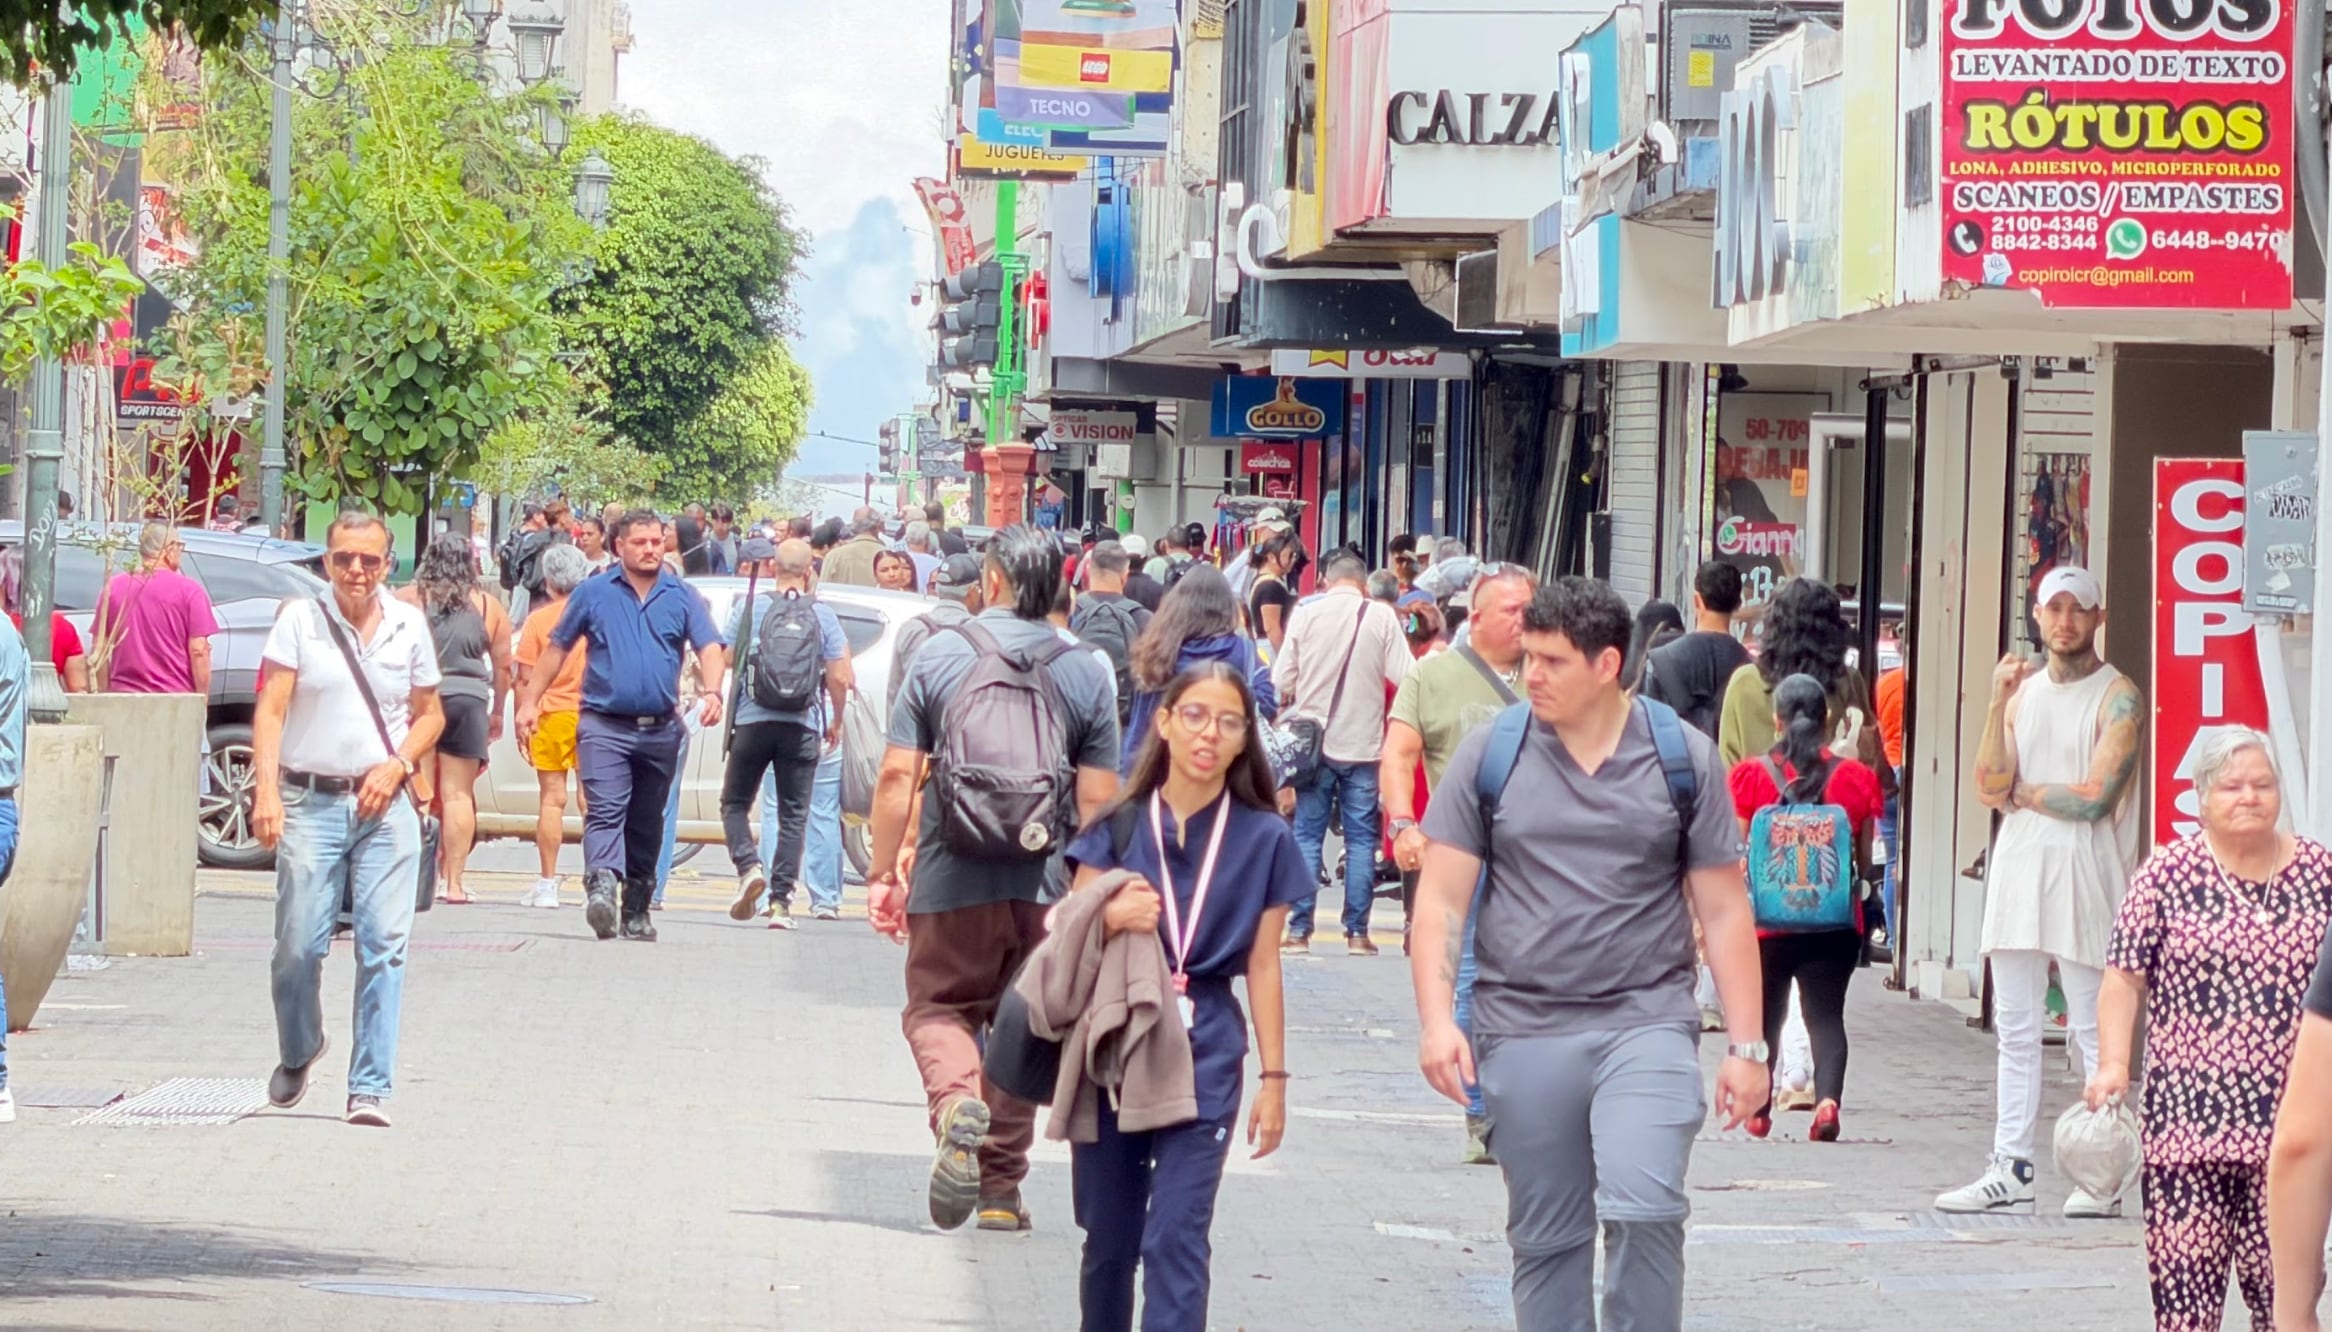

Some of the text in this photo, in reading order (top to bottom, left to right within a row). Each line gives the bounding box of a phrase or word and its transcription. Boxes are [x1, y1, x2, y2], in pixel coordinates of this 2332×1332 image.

[1956, 54, 2281, 79] LEVANTADO DE TEXTO
[1030, 99, 1091, 117] TECNO
[1966, 92, 2264, 150] RÓTULOS
[1950, 161, 2281, 178] LONA, ADHESIVO, MICROPERFORADO
[1992, 216, 2099, 233] 2100-4346
[1992, 234, 2098, 251] 8842-8344
[1252, 410, 1321, 427] GOLLO
[1071, 424, 1134, 440] VISION
